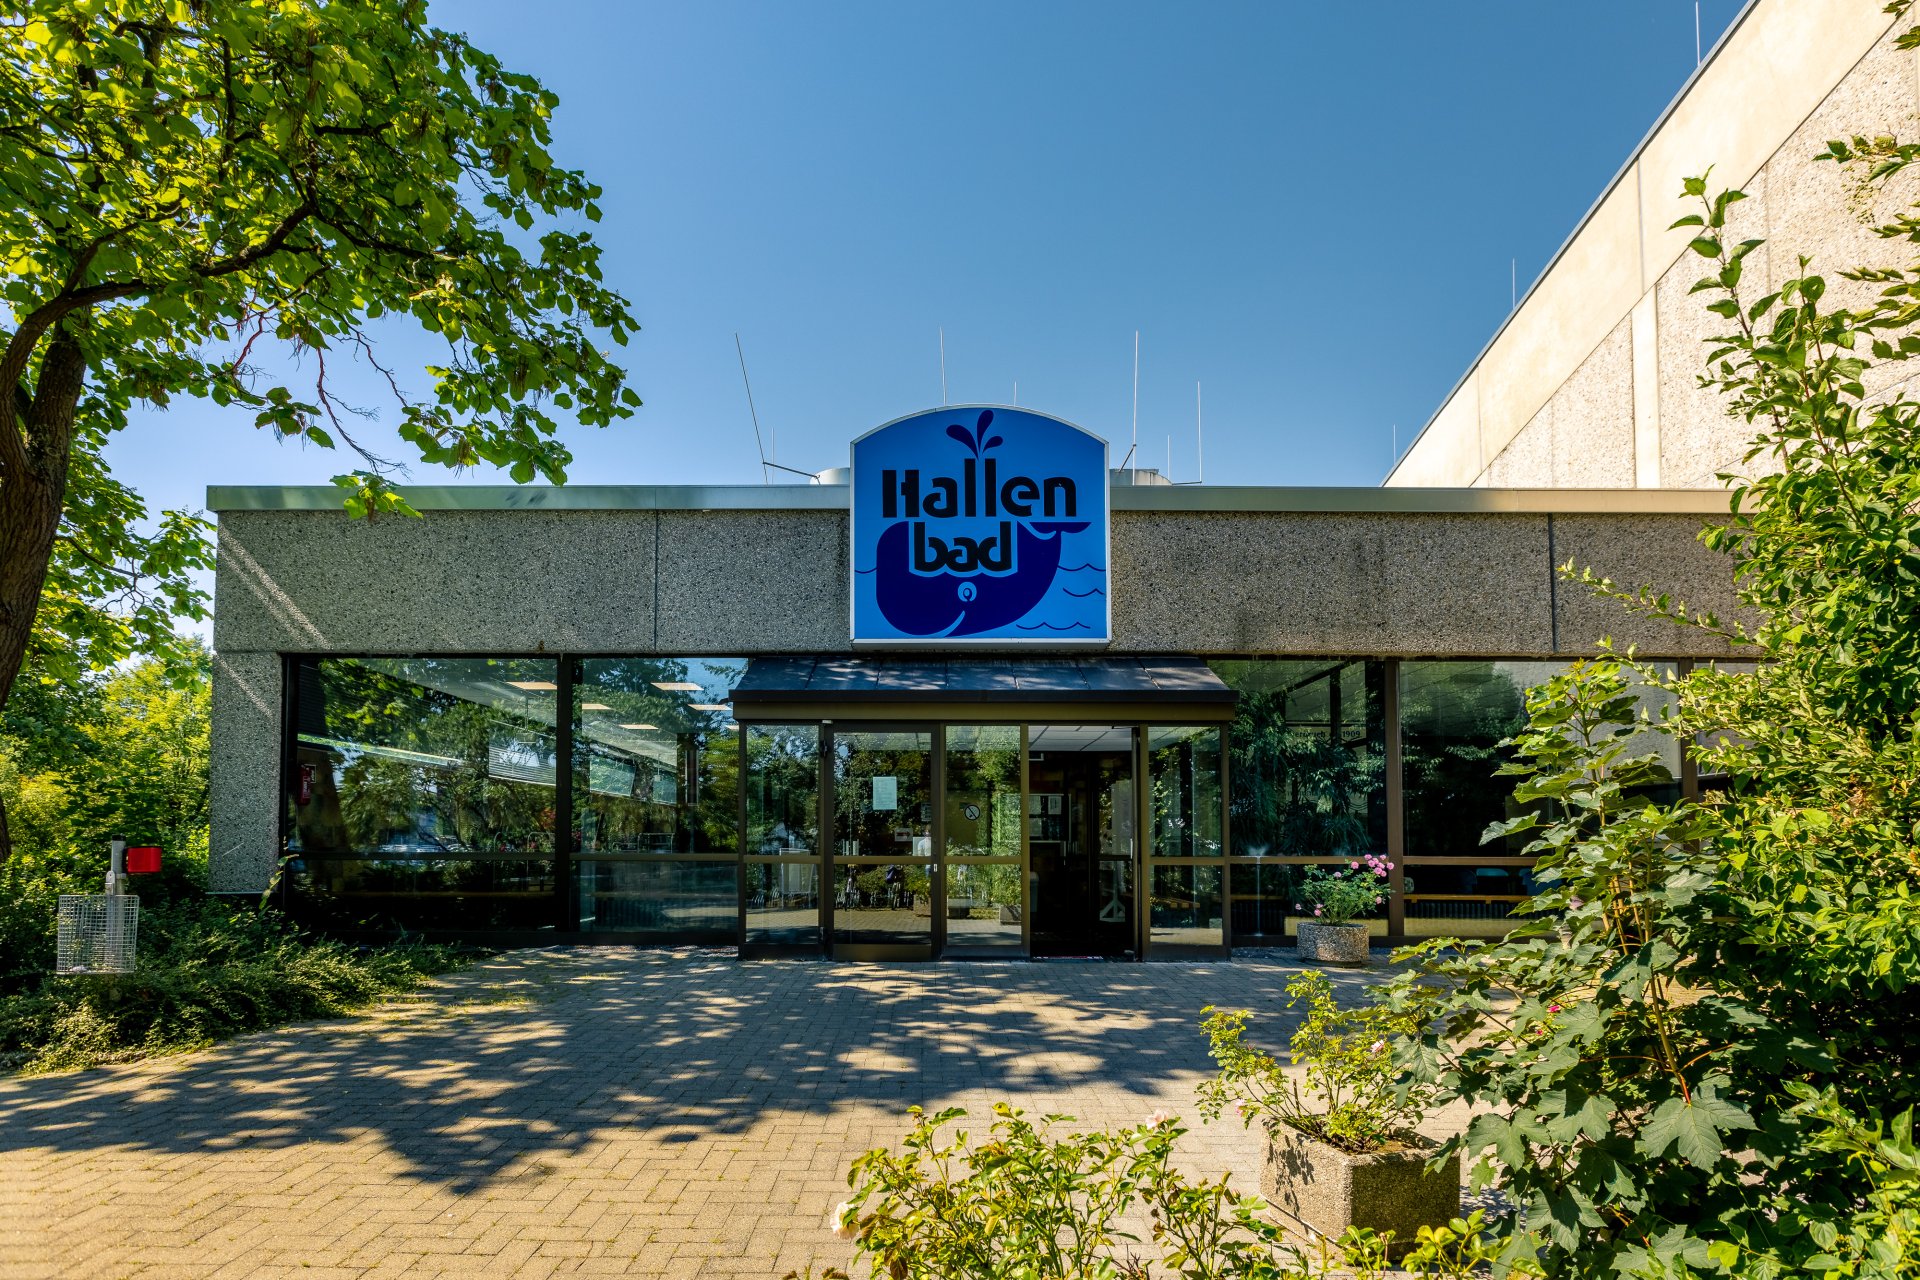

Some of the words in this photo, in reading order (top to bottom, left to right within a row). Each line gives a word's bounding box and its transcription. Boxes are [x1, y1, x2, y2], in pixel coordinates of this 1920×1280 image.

[881, 458, 1077, 519] Hallen
[913, 521, 1013, 573] bad
[1342, 730, 1361, 738] 1909
